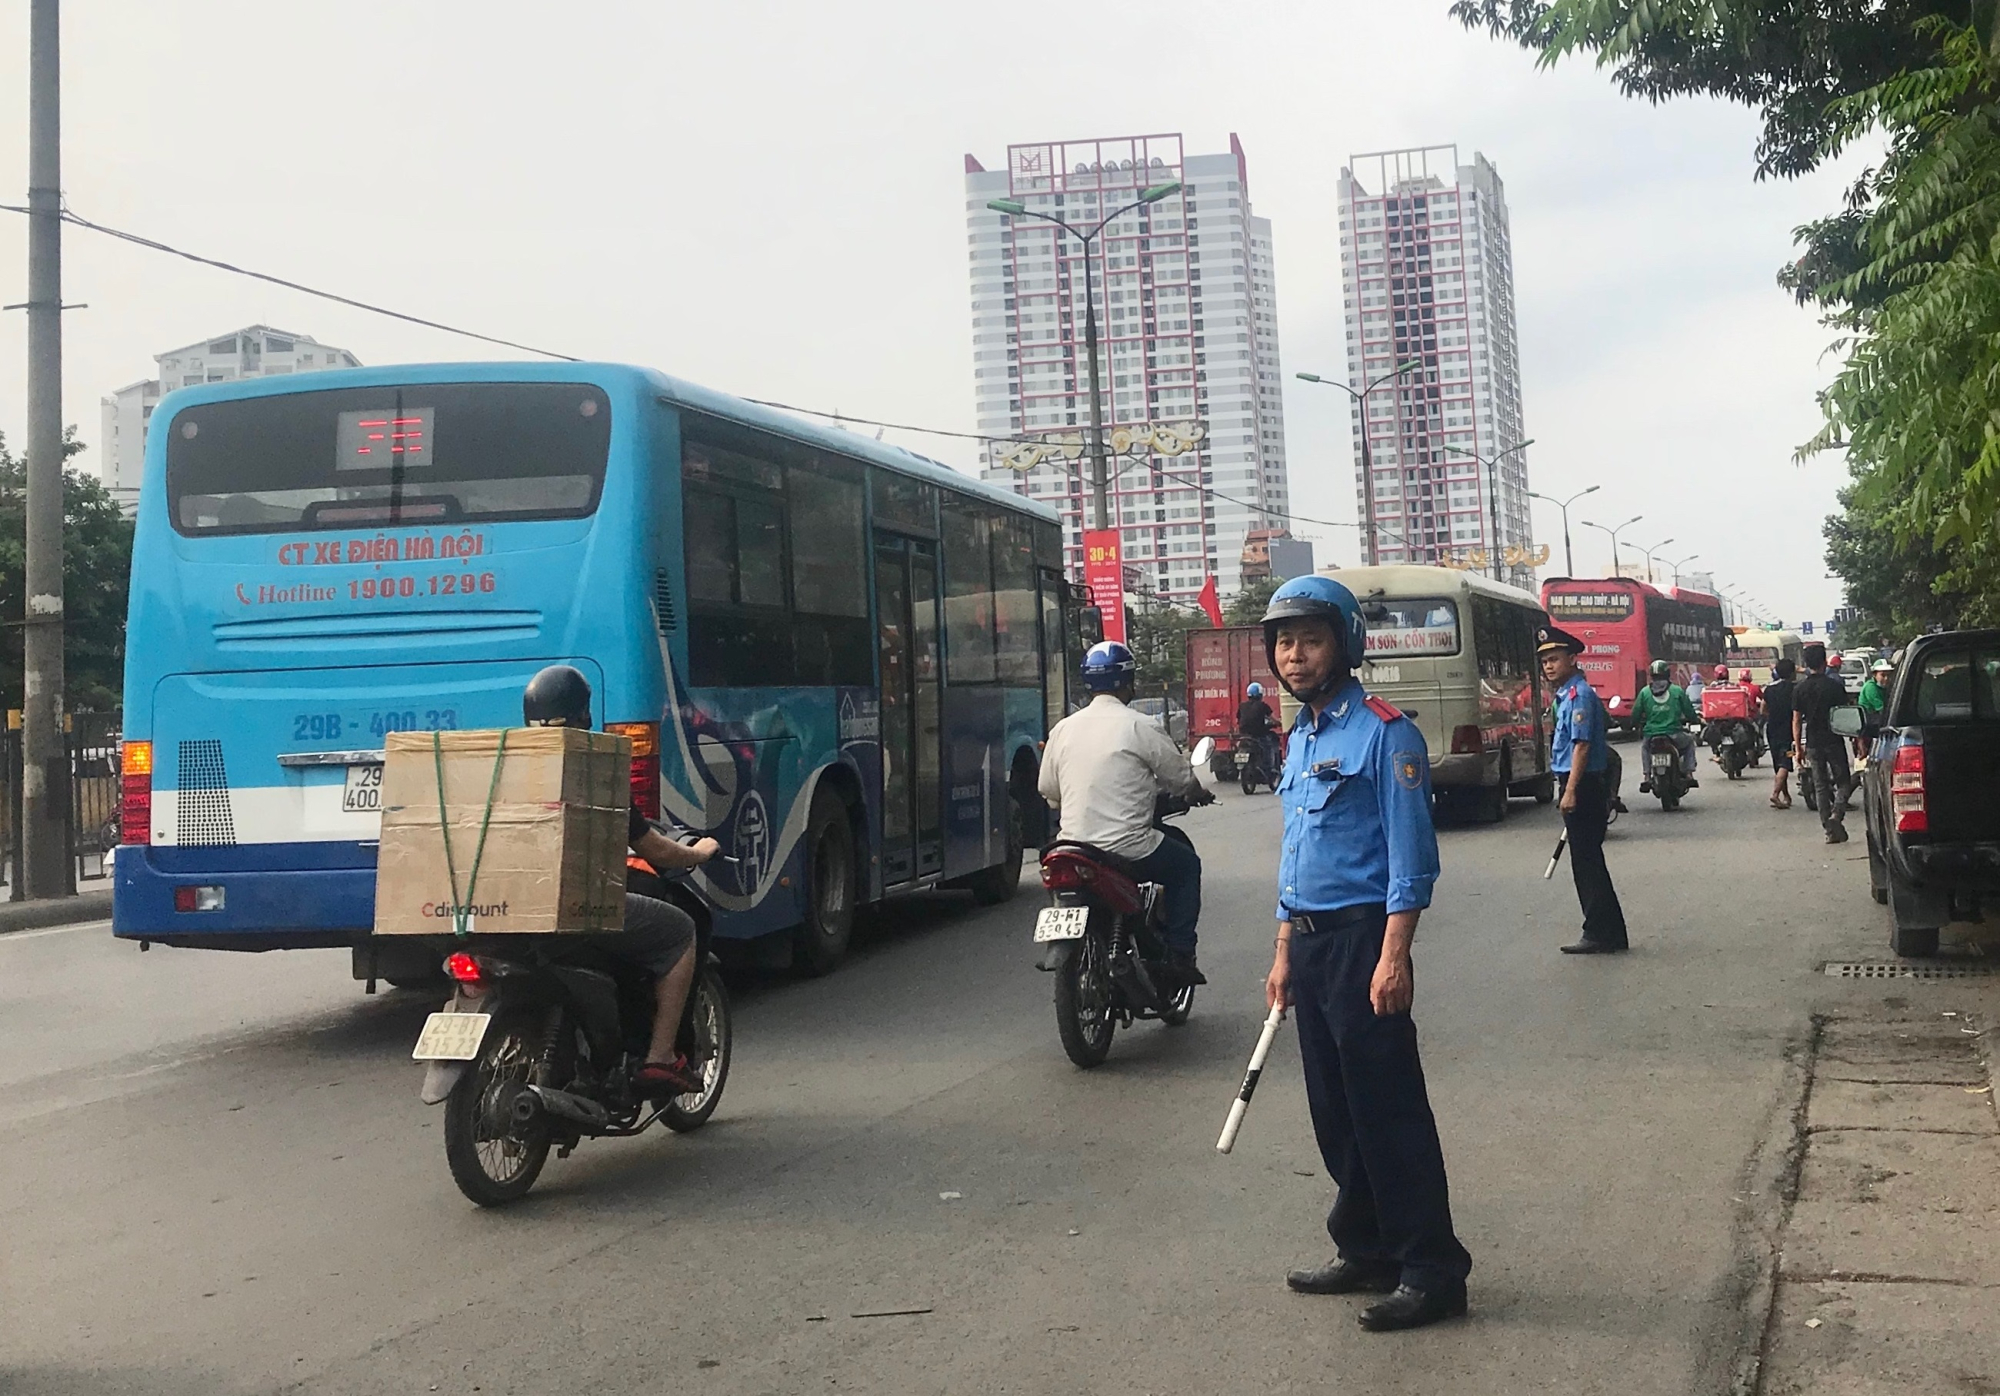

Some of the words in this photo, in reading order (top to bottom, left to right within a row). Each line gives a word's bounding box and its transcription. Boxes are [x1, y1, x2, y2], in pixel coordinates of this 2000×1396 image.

[278, 542, 310, 566] CT
[314, 540, 341, 564] XE
[257, 583, 337, 604] Hotline
[347, 572, 496, 599] 1900.1296
[1591, 645, 1620, 653] PHONG
[293, 713, 341, 741] 29B
[369, 709, 458, 738] 40033
[1205, 718, 1221, 727] 29C
